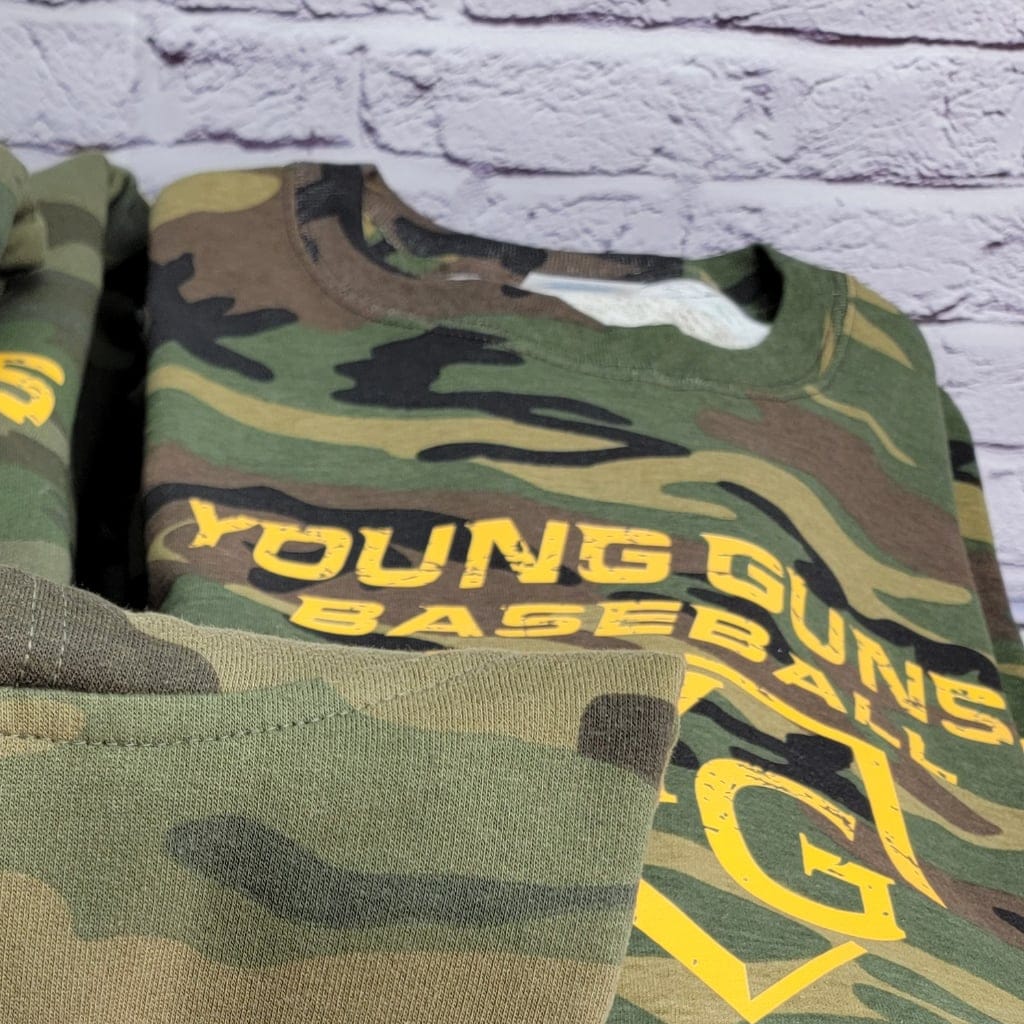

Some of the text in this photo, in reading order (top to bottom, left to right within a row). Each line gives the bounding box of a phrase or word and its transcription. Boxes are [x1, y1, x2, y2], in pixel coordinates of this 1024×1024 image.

[188, 499, 1014, 746] YOUNG GUNS
[289, 597, 958, 785] BASEBALL
